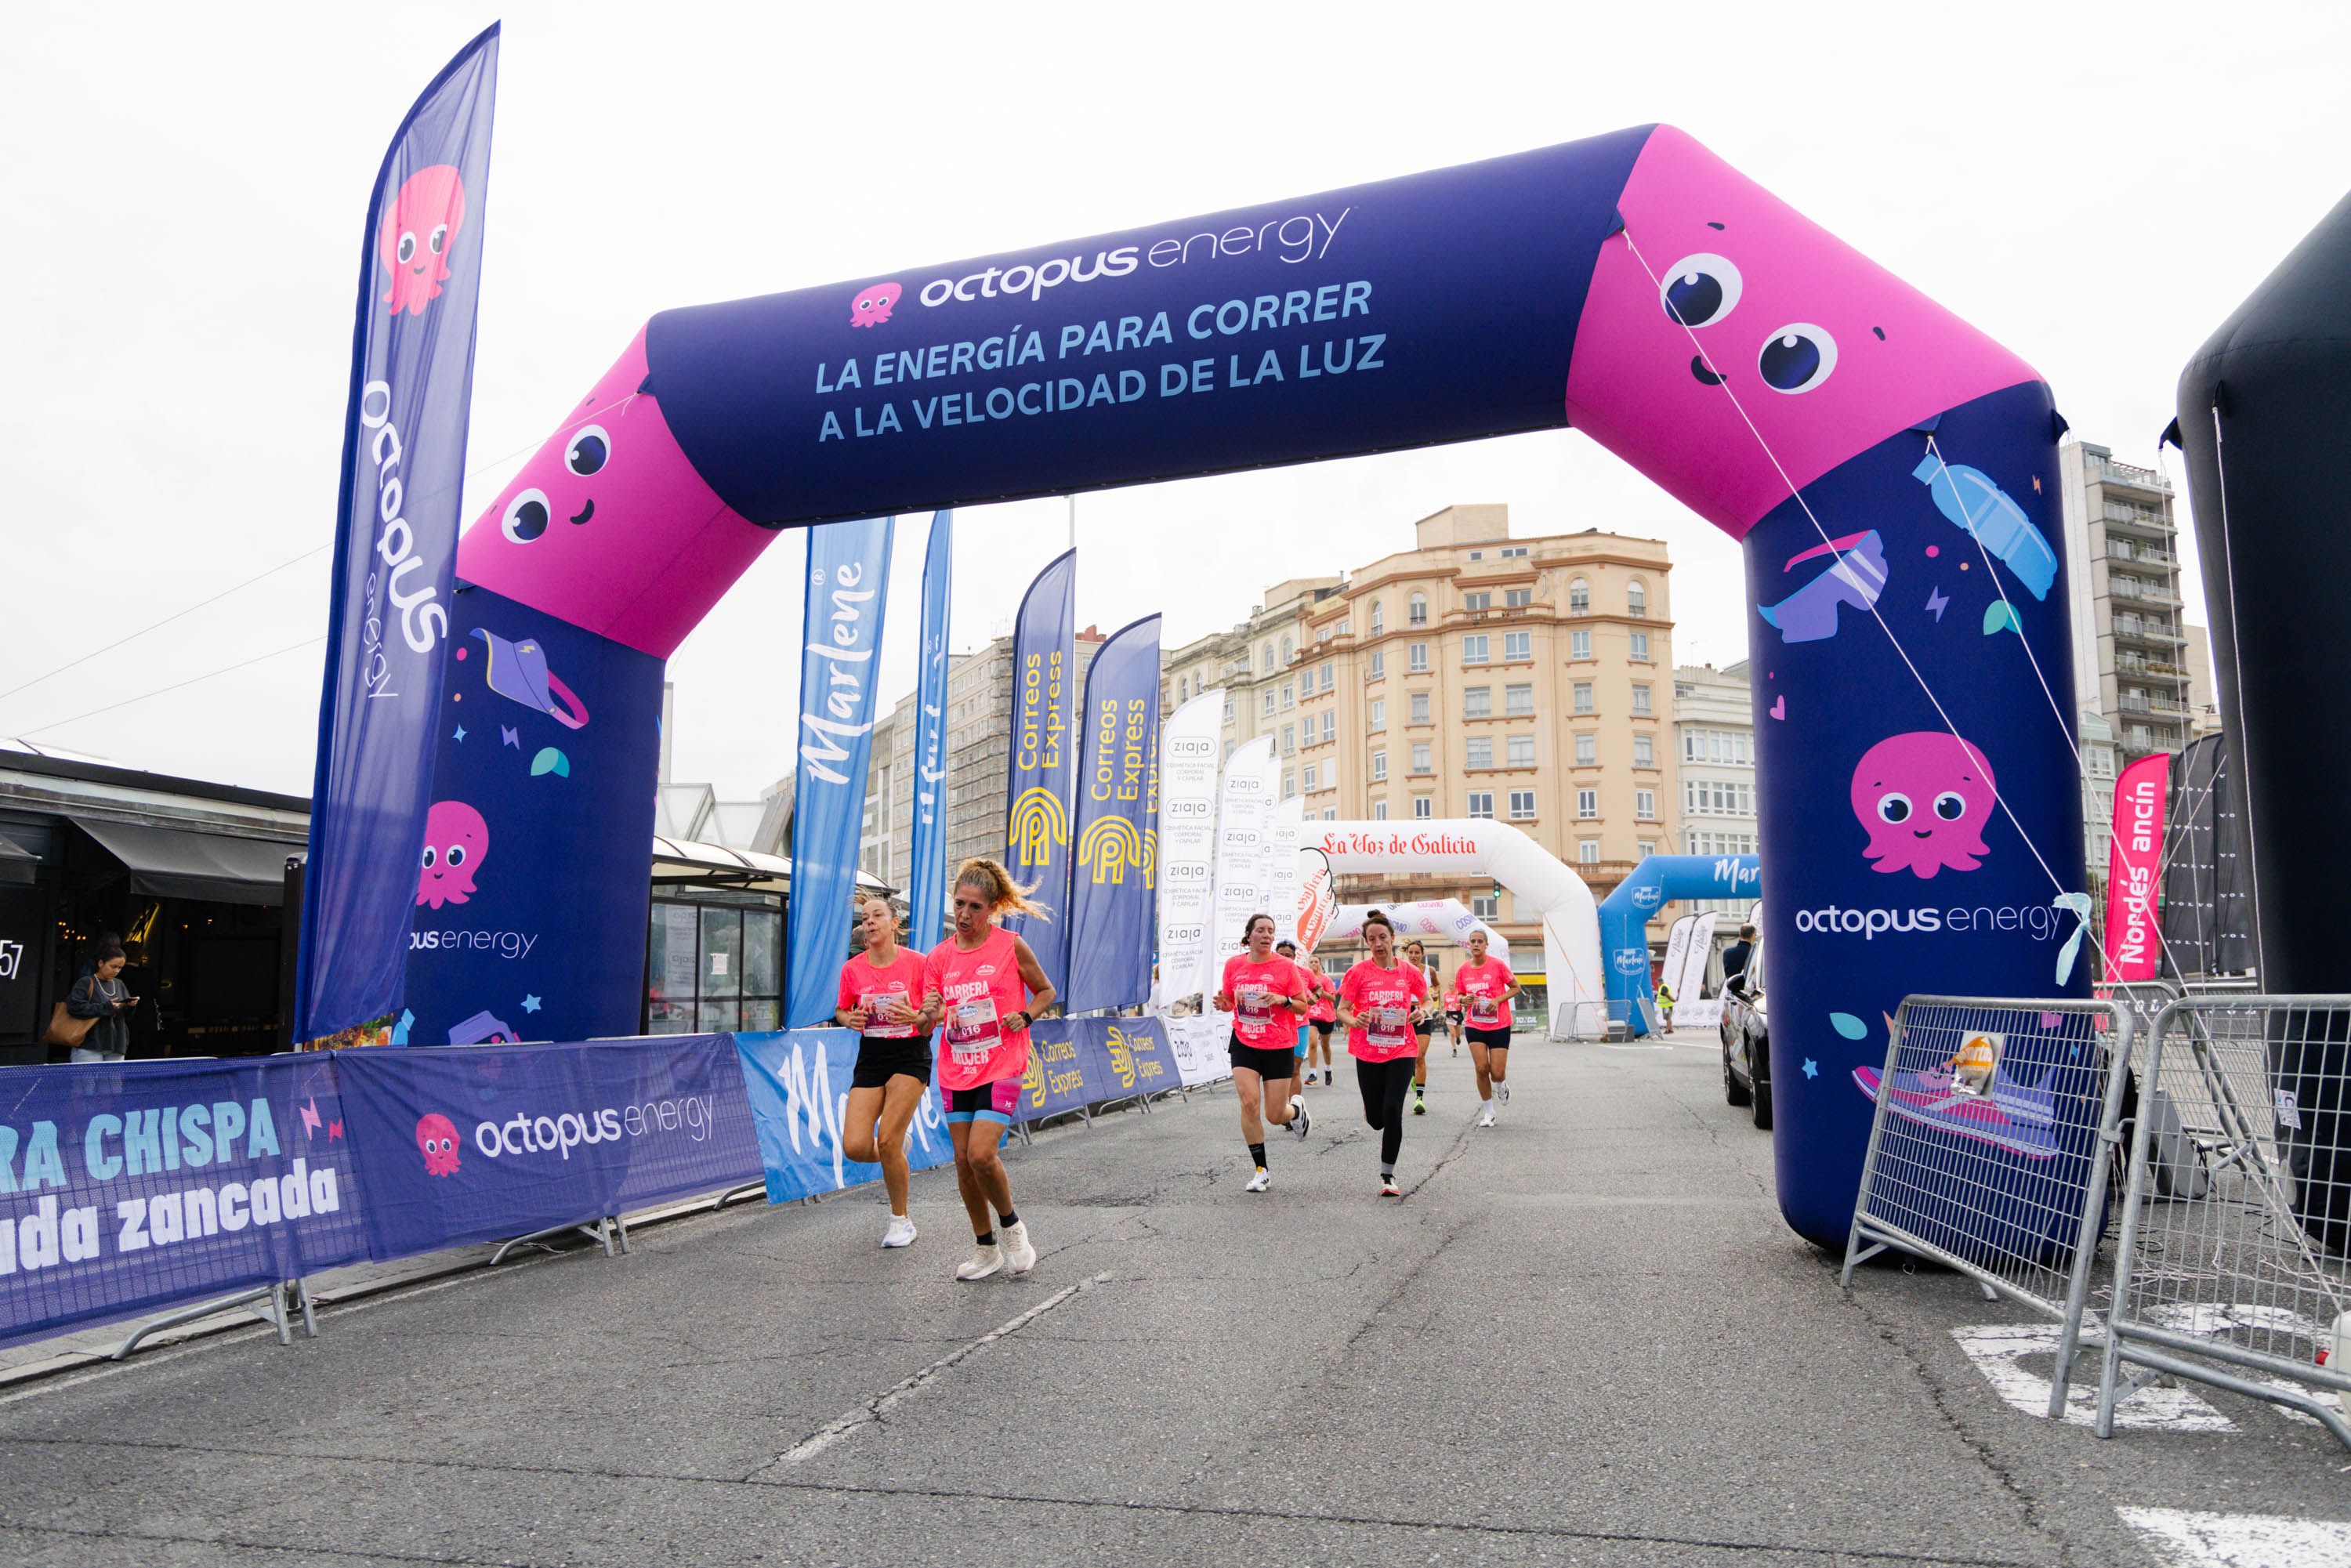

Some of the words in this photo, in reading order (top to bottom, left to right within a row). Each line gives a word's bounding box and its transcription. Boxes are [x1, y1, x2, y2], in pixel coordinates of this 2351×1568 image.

[918, 245, 1139, 308] octopus
[1147, 206, 1350, 265] energy
[815, 357, 861, 394] LA
[873, 322, 1045, 386] ENERGÍA
[1058, 310, 1174, 360] PARA
[1187, 280, 1372, 339] CORRER
[818, 411, 845, 443] A
[855, 401, 904, 437] LA
[911, 369, 1147, 429] VELOCIDAD
[1160, 357, 1215, 399] DE
[1229, 349, 1284, 389] LA
[1299, 333, 1387, 379] LUZ
[362, 380, 447, 654] octopus
[364, 571, 399, 698] energy
[799, 560, 875, 785] Marlene
[1018, 652, 1041, 771] Correos
[1041, 650, 1063, 769] Express
[1091, 698, 1118, 802] Correos
[1117, 698, 1146, 802] Express
[1173, 742, 1209, 755] ziaja
[1230, 780, 1259, 791] ziaja
[1172, 803, 1206, 816] ziaja
[2125, 781, 2155, 853] ancín
[1227, 833, 1256, 845] ziaja
[1318, 832, 1347, 854] La
[1348, 832, 1384, 857] Voz
[1389, 832, 1407, 854] de
[1411, 832, 1477, 855] Galicia
[1170, 866, 1204, 879] ziaja
[1223, 887, 1254, 900] ziaja
[1795, 905, 1941, 940] octopus
[1946, 904, 2062, 941] energy
[2119, 867, 2150, 965] Nordés
[441, 929, 538, 959] energy
[1168, 929, 1201, 941] ziaja
[943, 980, 990, 1001] CARRERA
[1369, 990, 1404, 1002] CARRERA
[961, 1025, 981, 1037] 016
[1241, 1023, 1266, 1034] MUJER
[952, 1050, 989, 1066] MUJER
[1041, 1040, 1077, 1063] Correos
[1047, 1069, 1084, 1097] Express
[84, 1097, 282, 1182] CHISPA
[475, 1108, 622, 1160] octopus
[625, 1095, 713, 1142] energy
[118, 1157, 339, 1253] zancada
